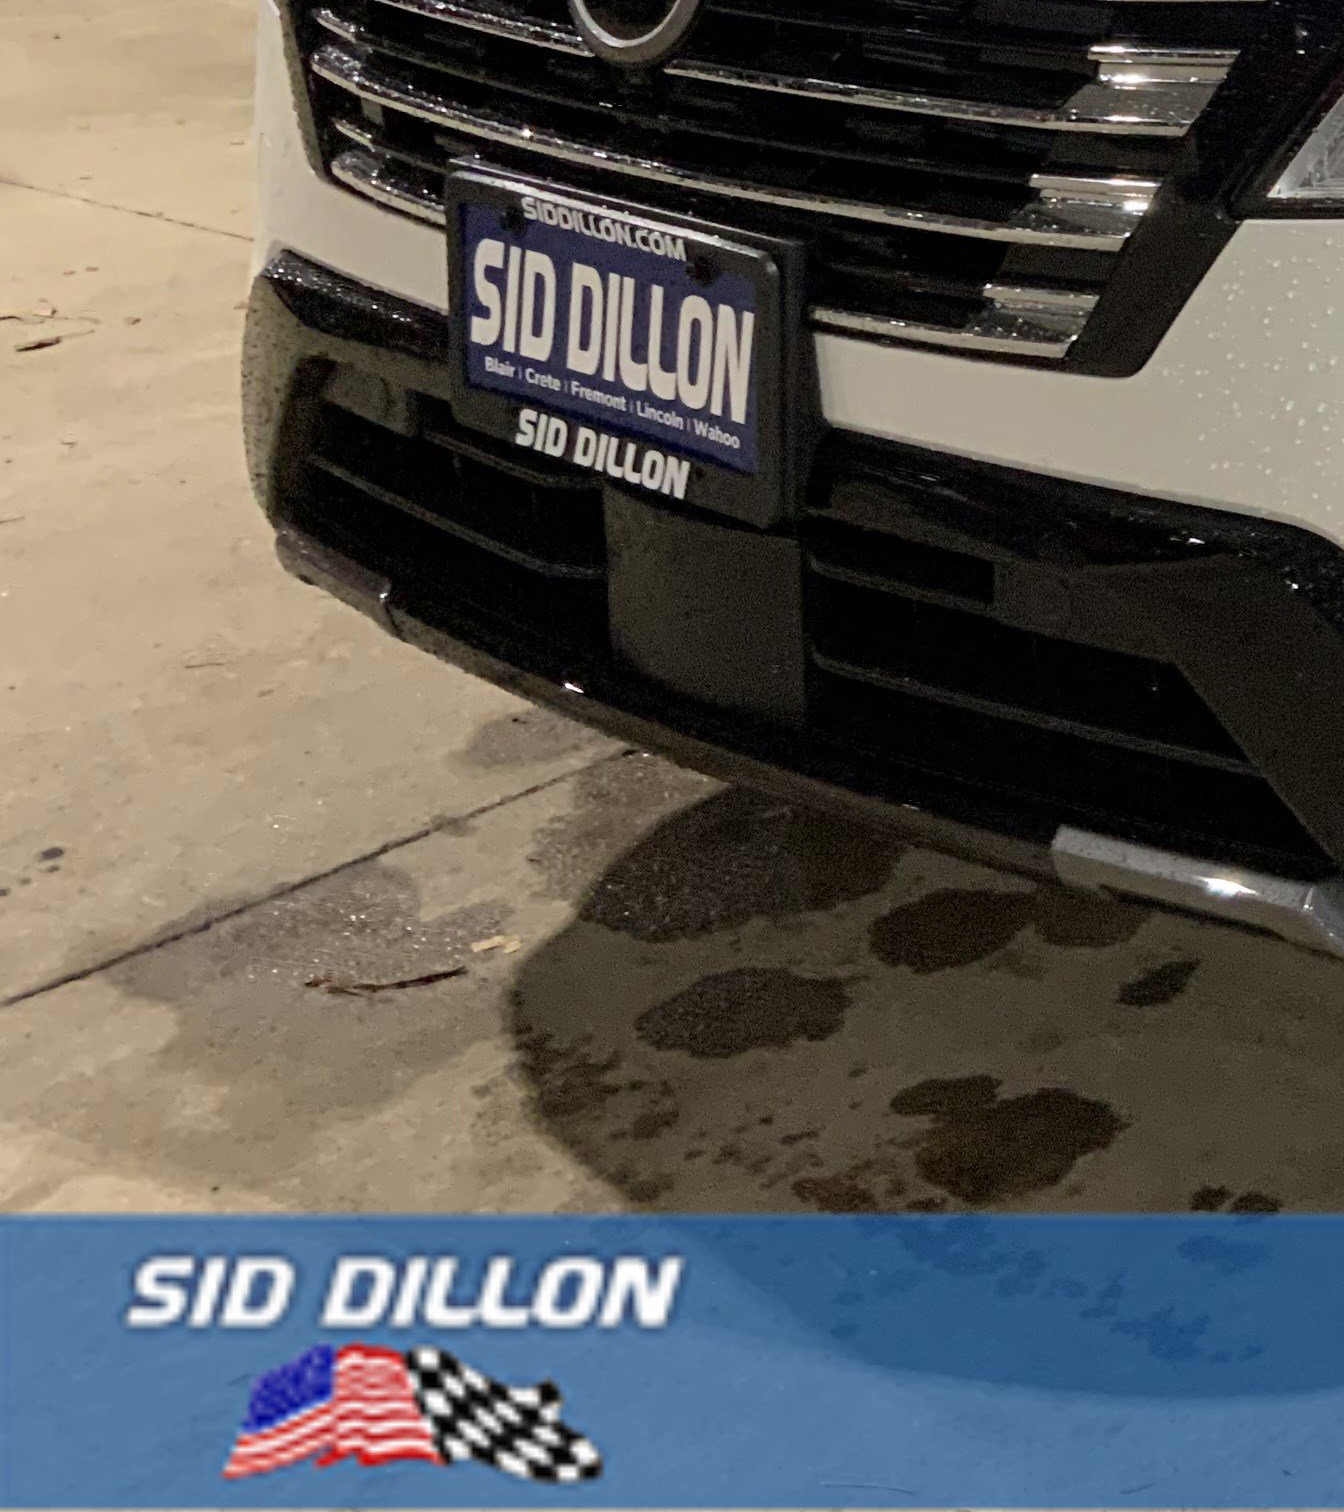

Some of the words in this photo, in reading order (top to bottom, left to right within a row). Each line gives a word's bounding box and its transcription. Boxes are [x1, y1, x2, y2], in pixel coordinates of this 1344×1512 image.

[520, 196, 687, 263] SIDDILLON.COM
[470, 237, 556, 363] SID
[566, 262, 755, 425] DILLON
[484, 356, 516, 379] Blair
[525, 367, 561, 392] Crete
[571, 381, 627, 413] Fremont
[636, 400, 684, 432] Lincoln
[693, 418, 741, 449] Wahoo
[515, 408, 567, 458] SID
[573, 426, 691, 500] DILLON
